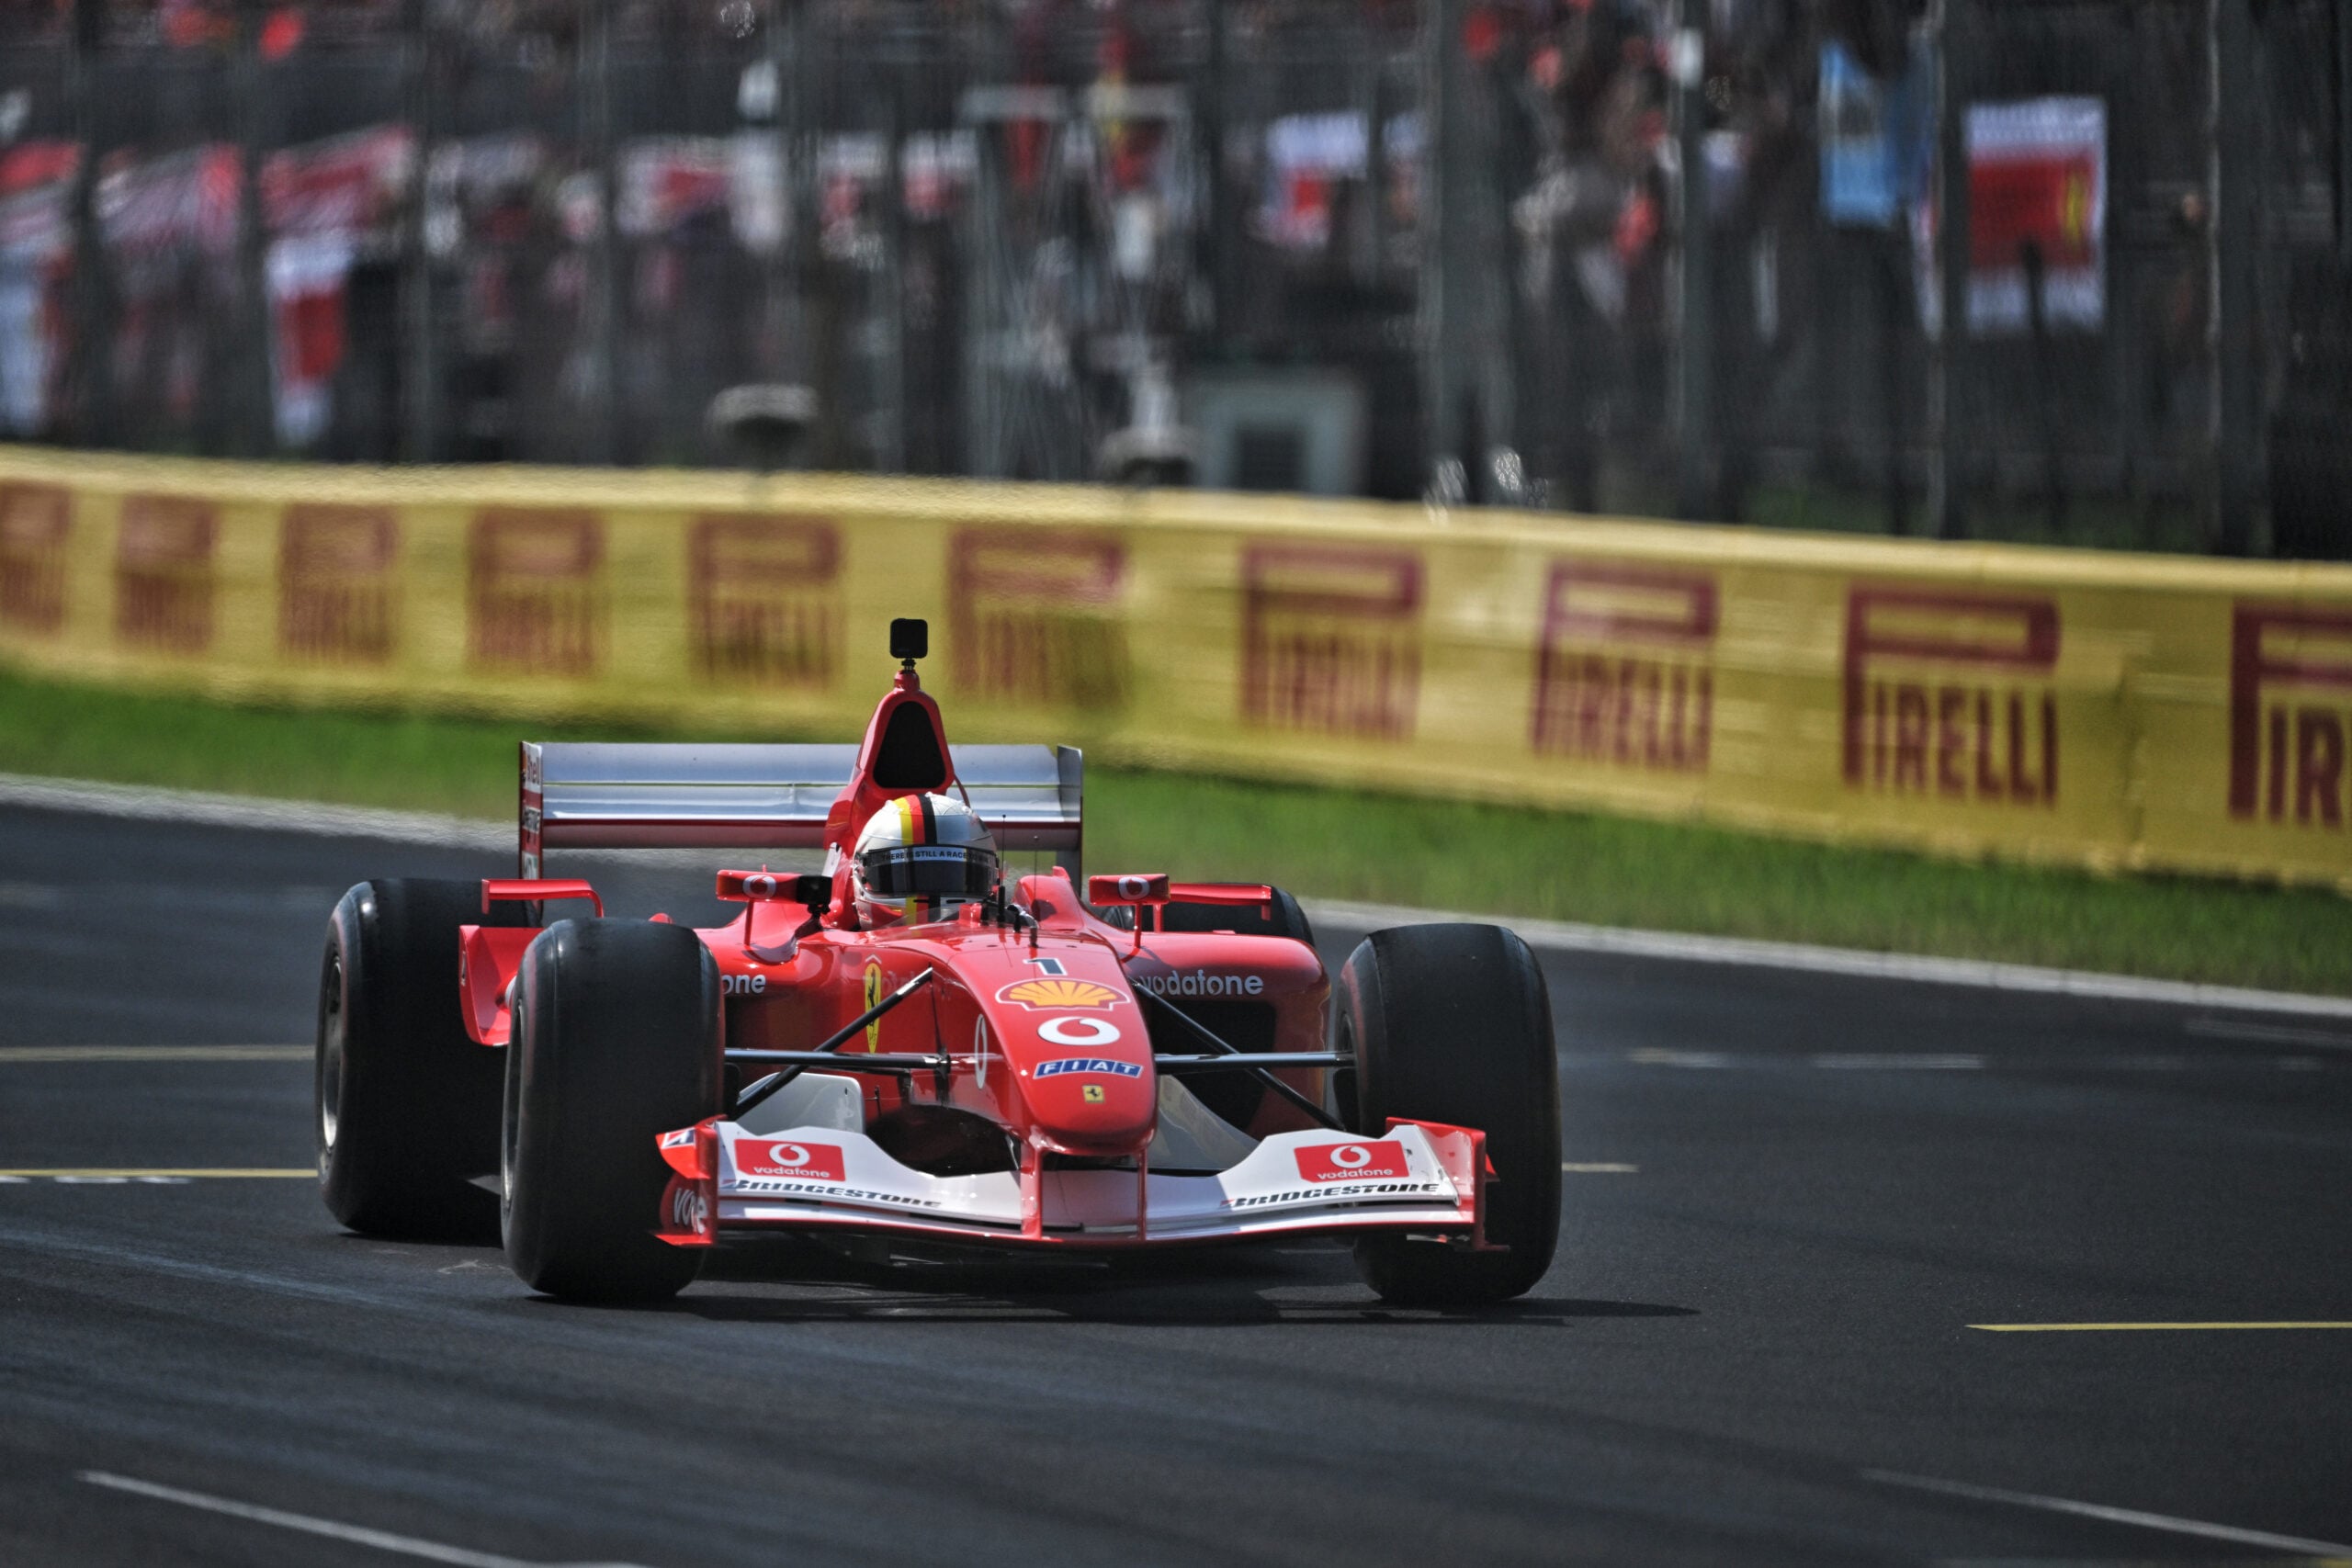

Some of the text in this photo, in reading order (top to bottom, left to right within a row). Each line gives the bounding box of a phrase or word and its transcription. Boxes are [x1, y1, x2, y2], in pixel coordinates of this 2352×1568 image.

[1841, 584, 2062, 807] PIRELLI
[915, 850, 937, 858] STILL
[939, 850, 945, 858] A
[946, 850, 967, 859] RACE
[1023, 957, 1068, 976] 1
[1139, 969, 1264, 996] vodafone
[1040, 1058, 1139, 1076] FIAT
[752, 1166, 831, 1179] vodafone
[1317, 1168, 1394, 1180] vodafone
[721, 1179, 942, 1209] BRIDGESTONE
[1222, 1183, 1440, 1208] BRIDGESTONE
